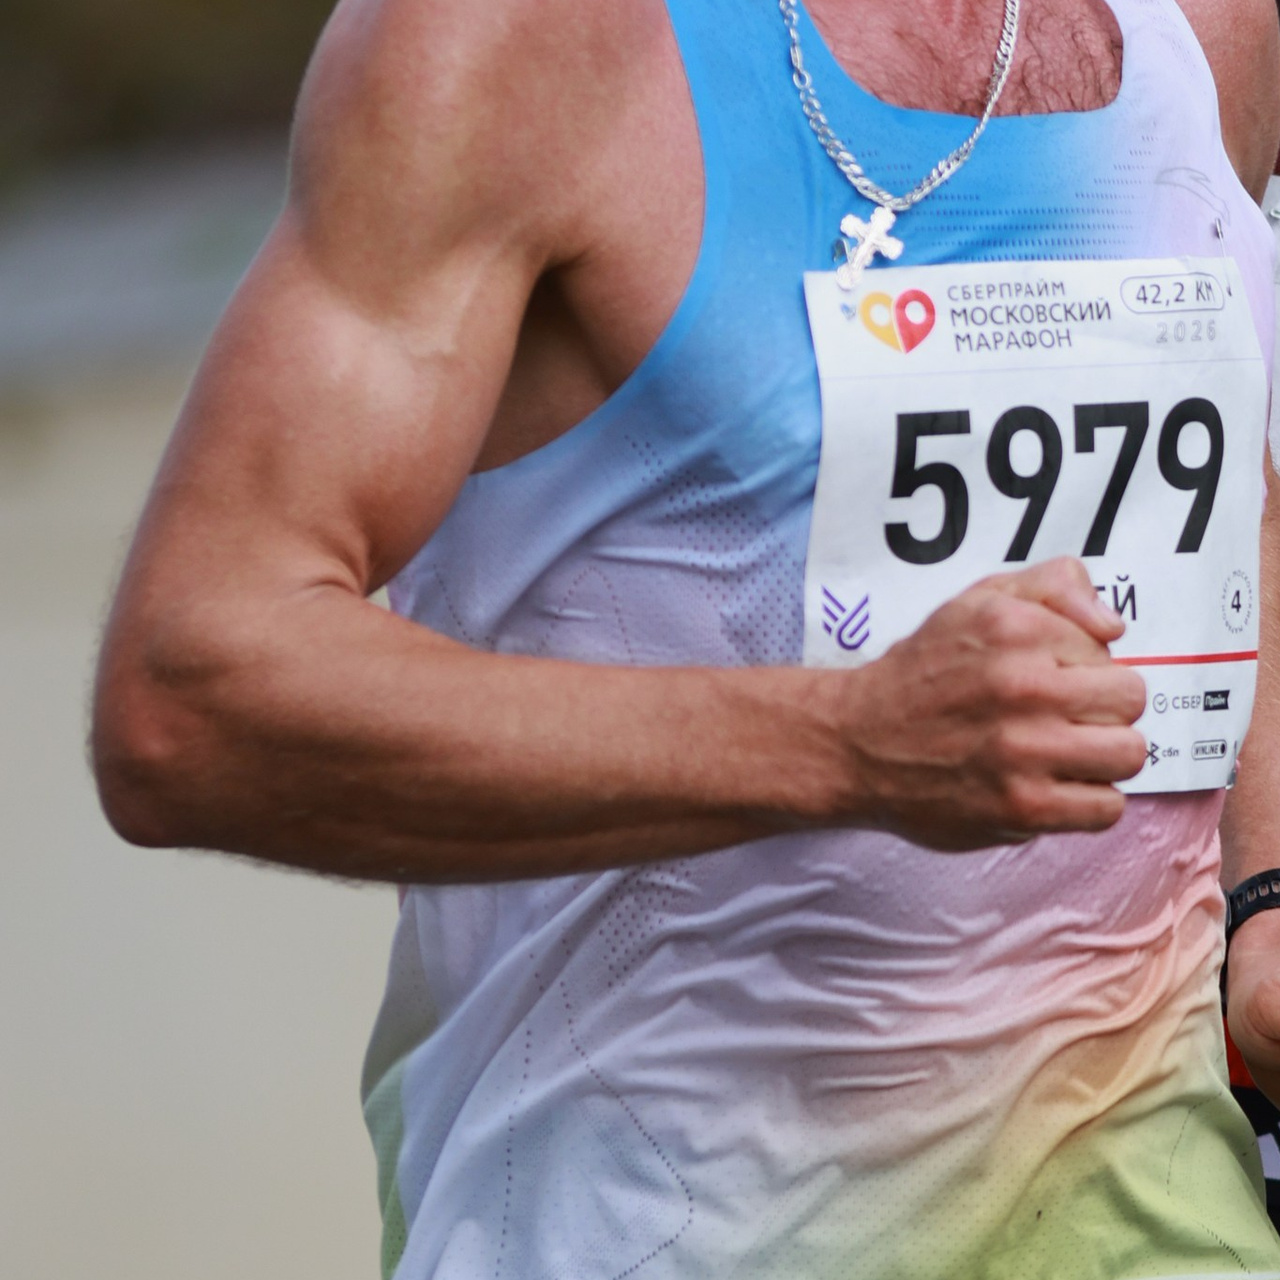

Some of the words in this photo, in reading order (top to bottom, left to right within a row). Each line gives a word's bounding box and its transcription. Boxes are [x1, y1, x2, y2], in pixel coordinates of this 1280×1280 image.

[947, 278, 1066, 301] СБЕРПРАЙМ
[1135, 282, 1186, 307] 42,2
[1195, 279, 1216, 302] КМ
[951, 296, 1112, 327] МОСКОВСКИЙ
[955, 328, 1072, 352] МАРАФОН
[1155, 319, 1217, 344] 2026
[883, 397, 1224, 566] 5979
[1094, 574, 1137, 621] Й
[1230, 589, 1242, 613] 4
[1171, 695, 1201, 710] СБЕР
